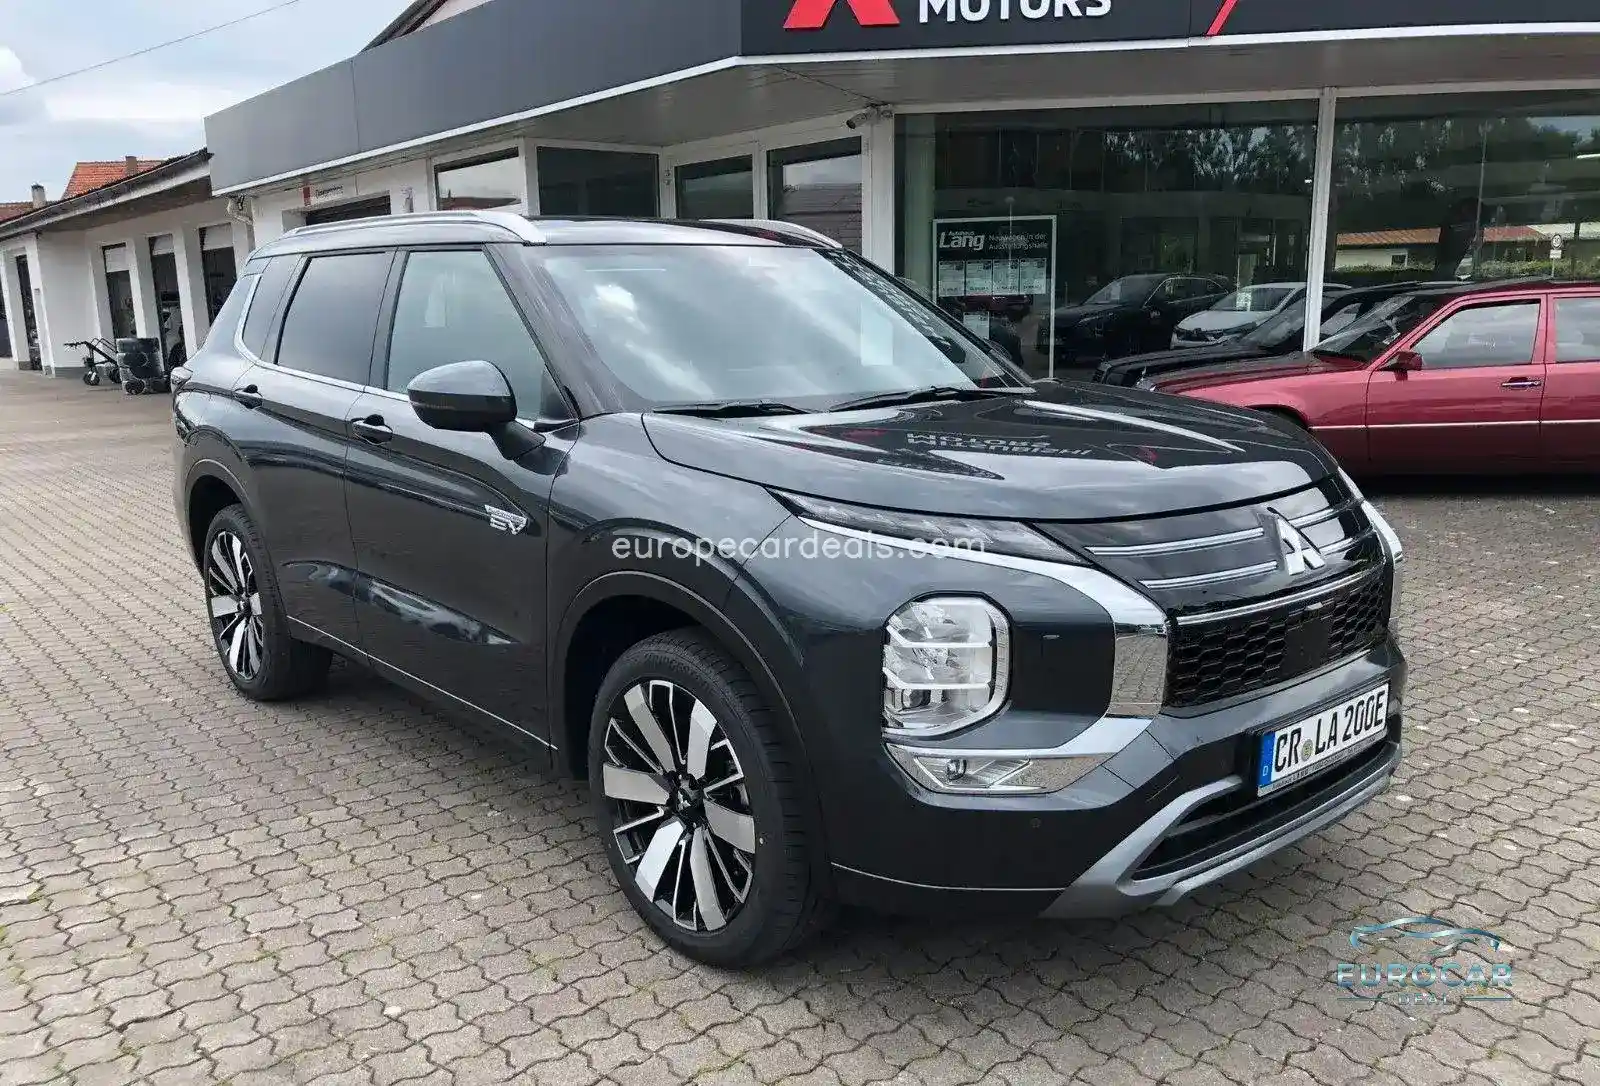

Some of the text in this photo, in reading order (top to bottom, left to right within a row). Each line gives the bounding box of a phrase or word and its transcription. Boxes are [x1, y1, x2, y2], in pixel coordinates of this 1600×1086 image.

[939, 231, 985, 251] Lang
[1275, 727, 1301, 772] CR
[1315, 712, 1338, 755] LA
[1342, 690, 1385, 741] 200E
